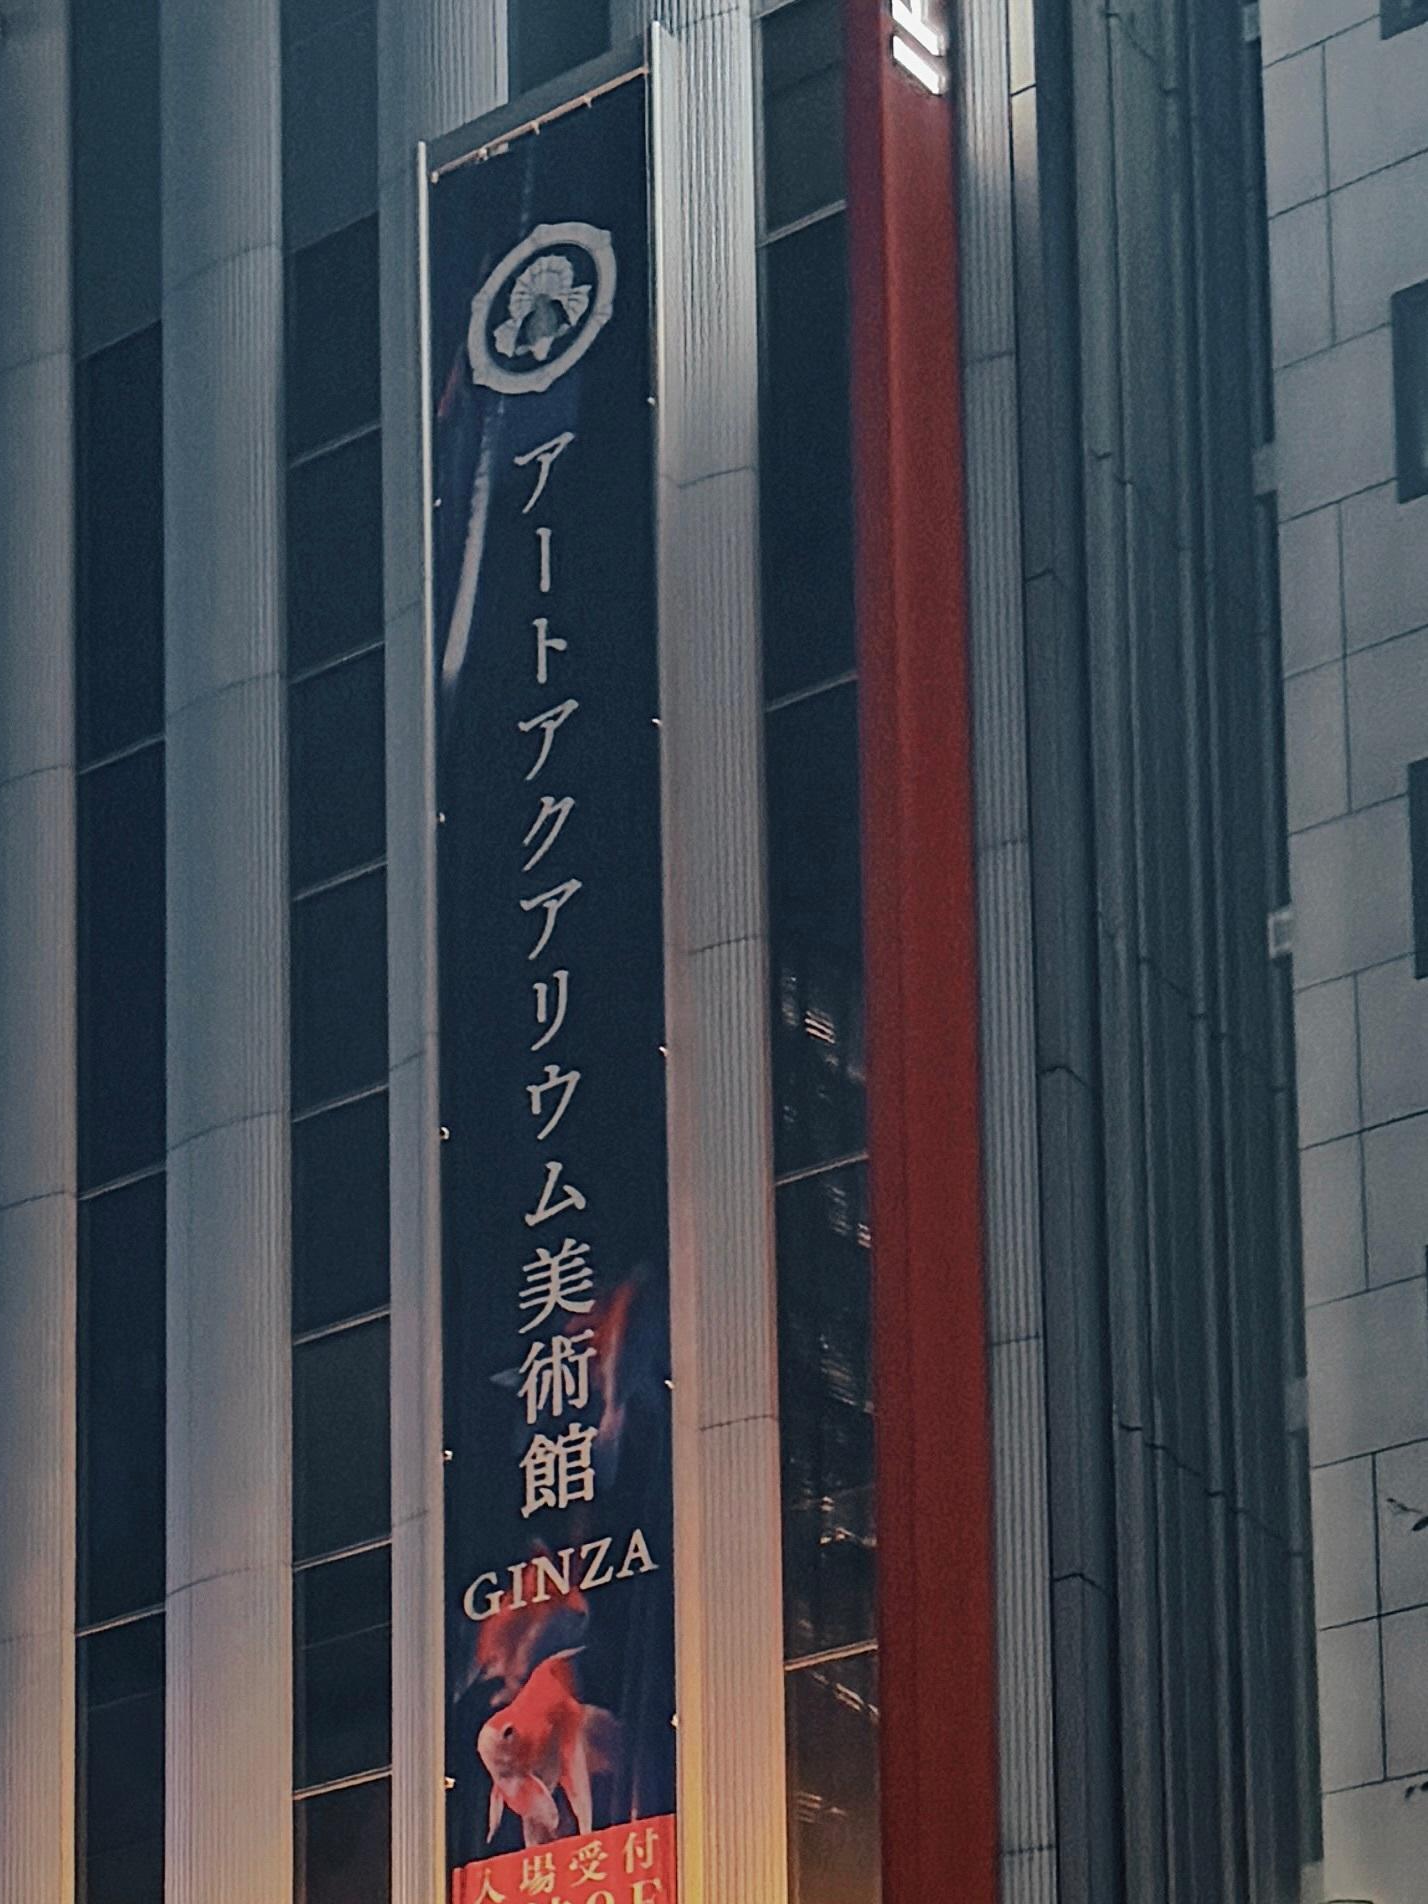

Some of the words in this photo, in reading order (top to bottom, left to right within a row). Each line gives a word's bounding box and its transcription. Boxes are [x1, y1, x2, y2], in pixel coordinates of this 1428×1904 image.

[513, 430, 599, 1518] アートアクアリウム美術館
[462, 1527, 659, 1624] GINZA
